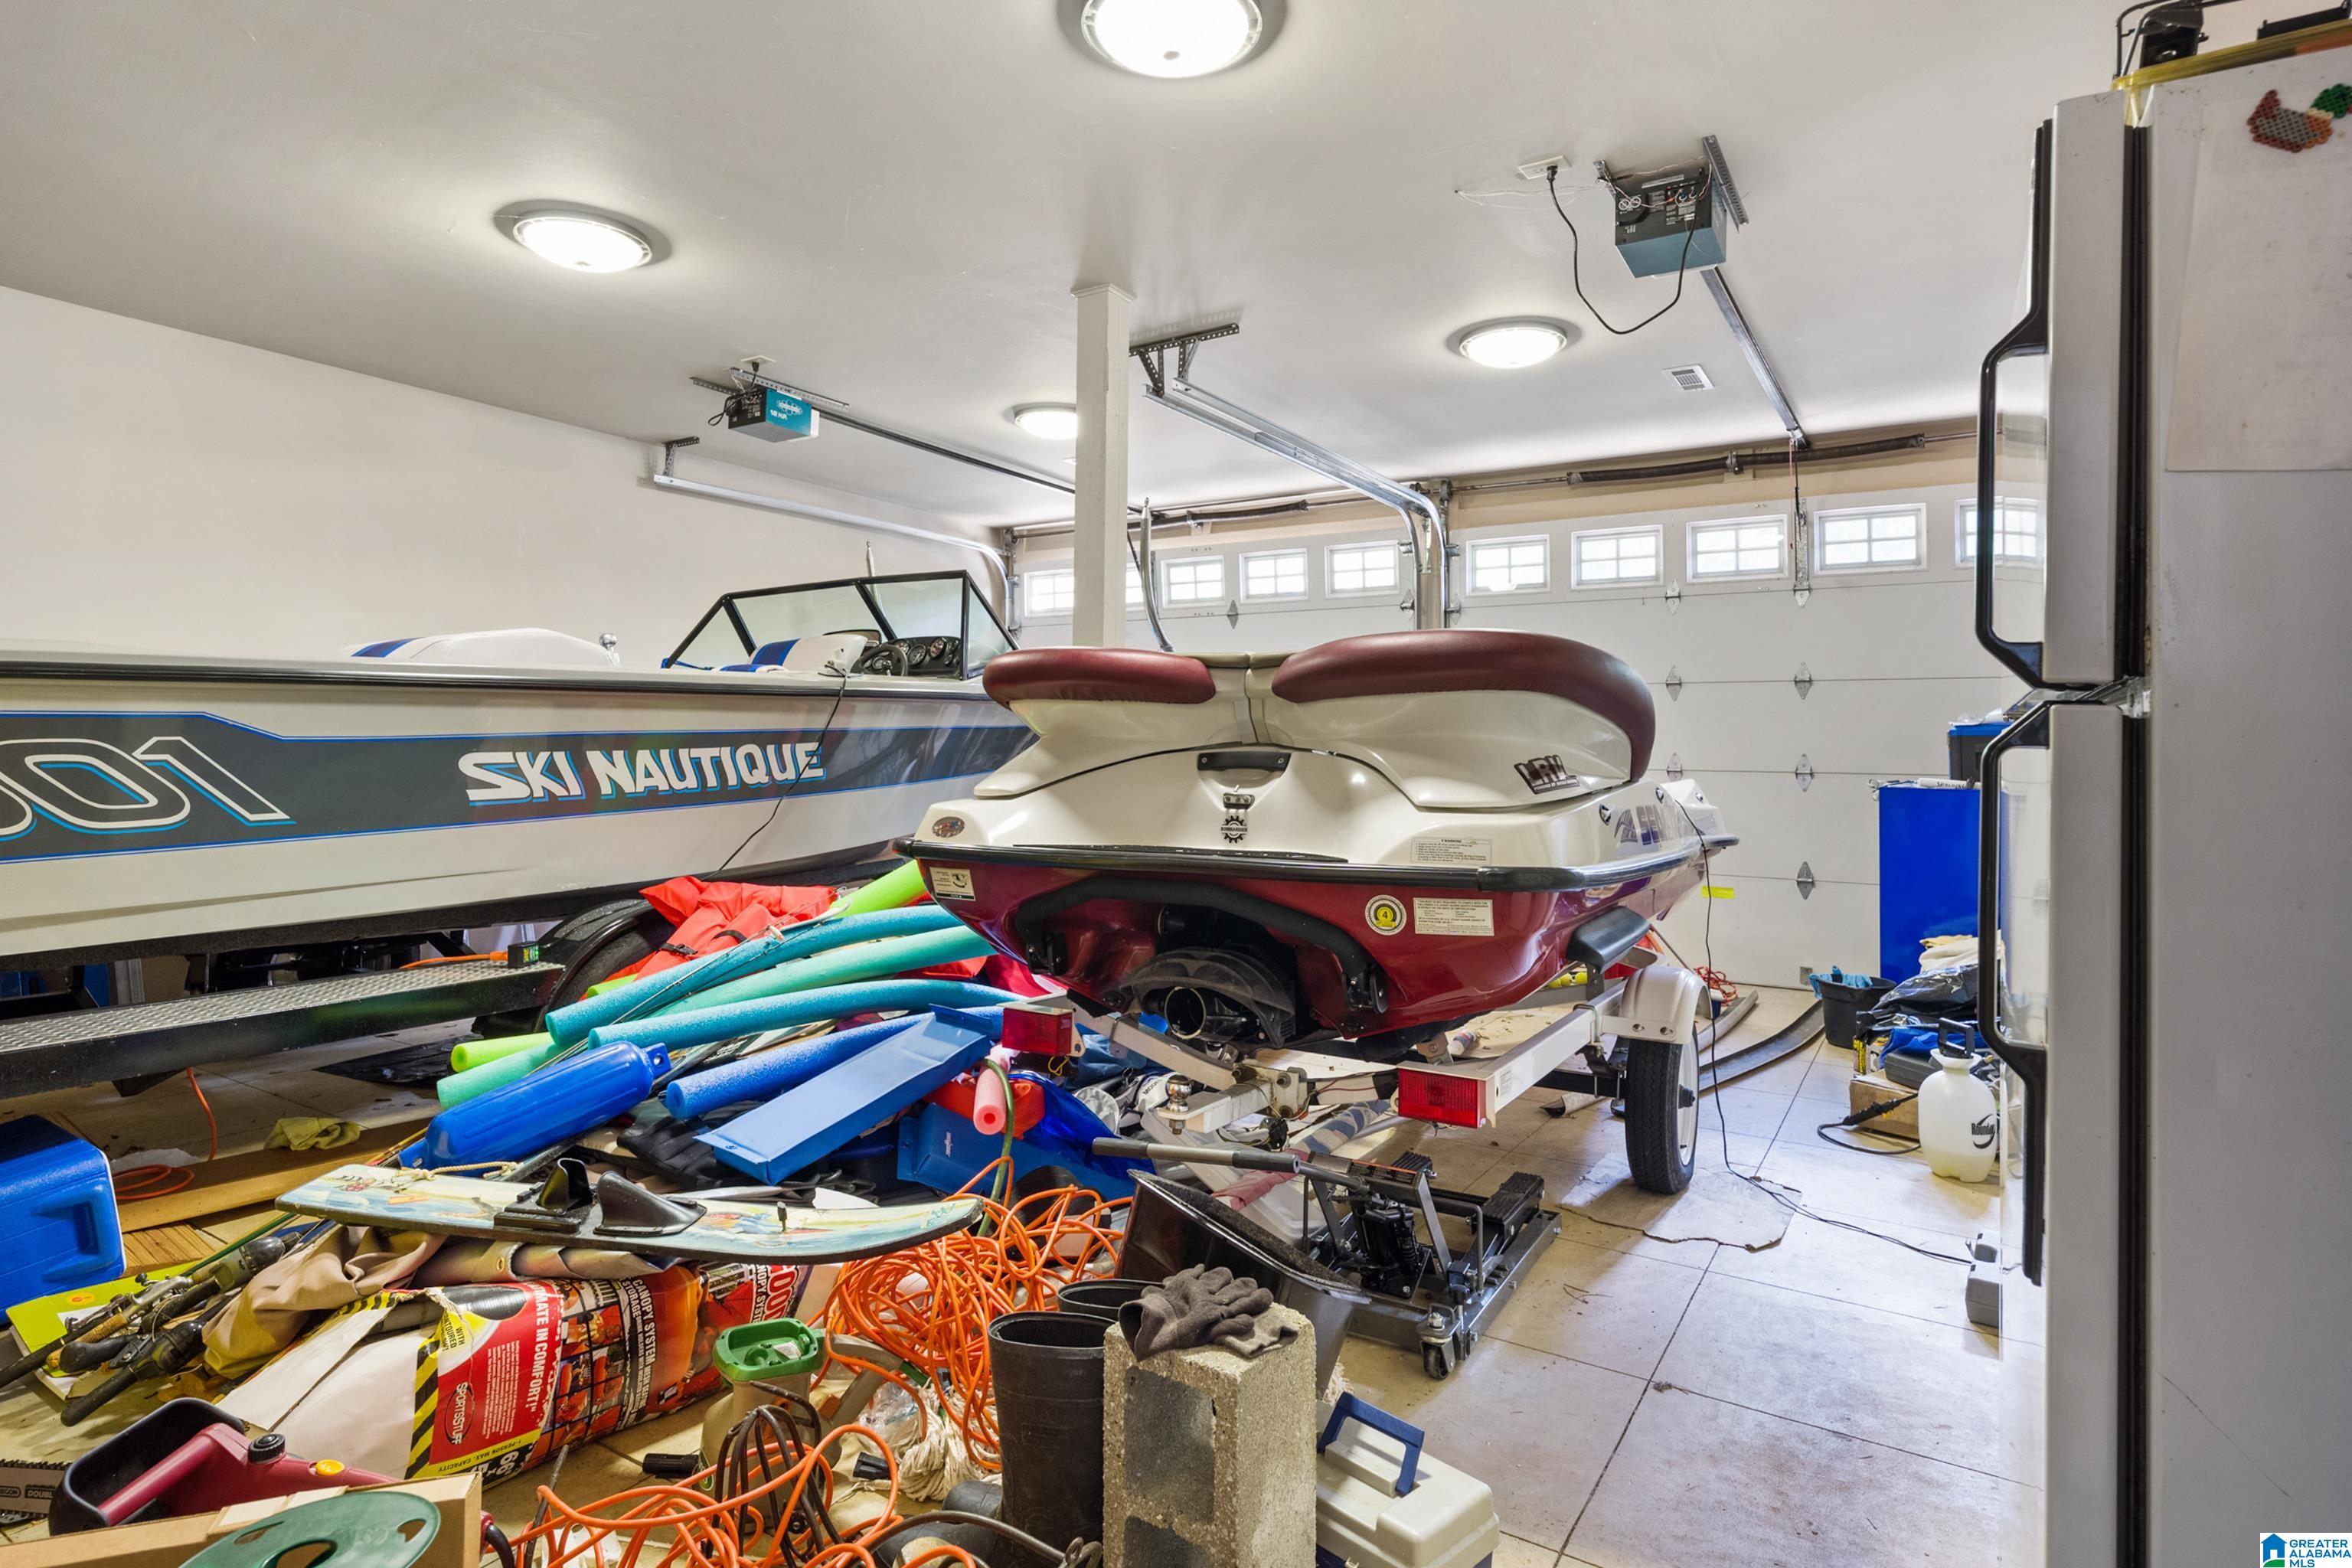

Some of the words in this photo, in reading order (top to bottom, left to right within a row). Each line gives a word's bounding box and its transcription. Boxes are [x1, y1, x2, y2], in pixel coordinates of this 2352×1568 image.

[458, 750, 584, 805] SKI
[586, 743, 825, 798] NAUTIQUE
[0, 736, 297, 841] 01
[756, 1265, 767, 1292] NOPY
[622, 1280, 642, 1318] STORAGE
[753, 1295, 766, 1324] SYSTE
[456, 1326, 466, 1346] WITH
[536, 1328, 549, 1341] IN
[632, 1279, 654, 1320] CANOPY
[644, 1321, 656, 1365] SYSTEM
[451, 1382, 469, 1445] SPORTSSTUFF
[437, 1457, 472, 1472] CAPACITY
[475, 1448, 490, 1462] MAX.
[27, 1489, 54, 1498] DOUBL
